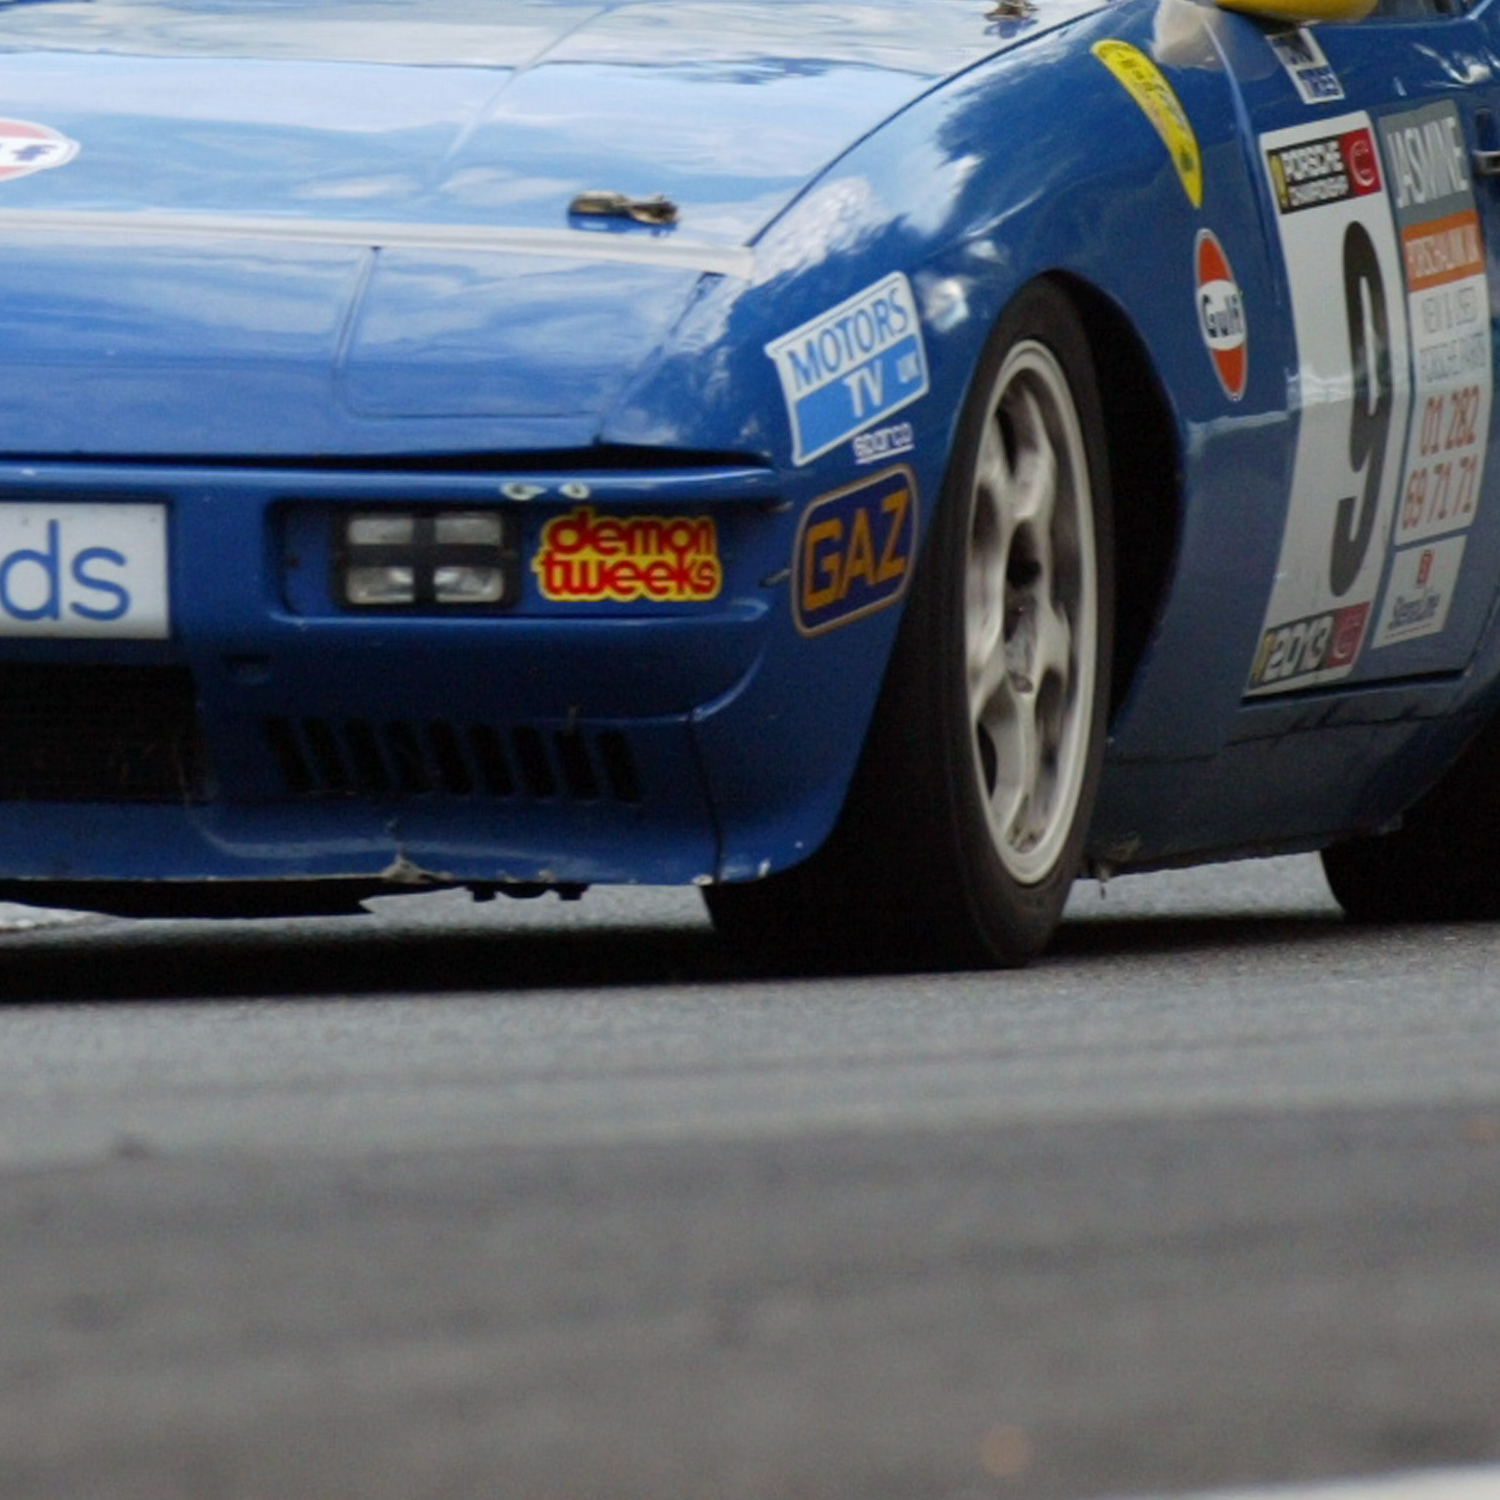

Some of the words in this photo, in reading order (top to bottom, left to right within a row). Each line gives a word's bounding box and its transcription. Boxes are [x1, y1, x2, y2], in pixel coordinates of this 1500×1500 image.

[1280, 138, 1346, 183] PORSCHE
[1387, 116, 1469, 209] JASMINE
[787, 286, 910, 392] MOTORS
[1202, 293, 1243, 339] Gulf
[842, 359, 883, 418] TV
[1330, 221, 1393, 596] 9
[1420, 395, 1444, 456] 01
[1444, 384, 1481, 451] 282
[853, 422, 913, 459] sparco
[1402, 467, 1427, 530] 69
[1427, 461, 1452, 523] 71
[1452, 454, 1477, 517] 71
[547, 508, 715, 555] demon
[803, 488, 909, 612] GAZ
[541, 548, 719, 596] tweeks
[1263, 614, 1335, 682] 2013
